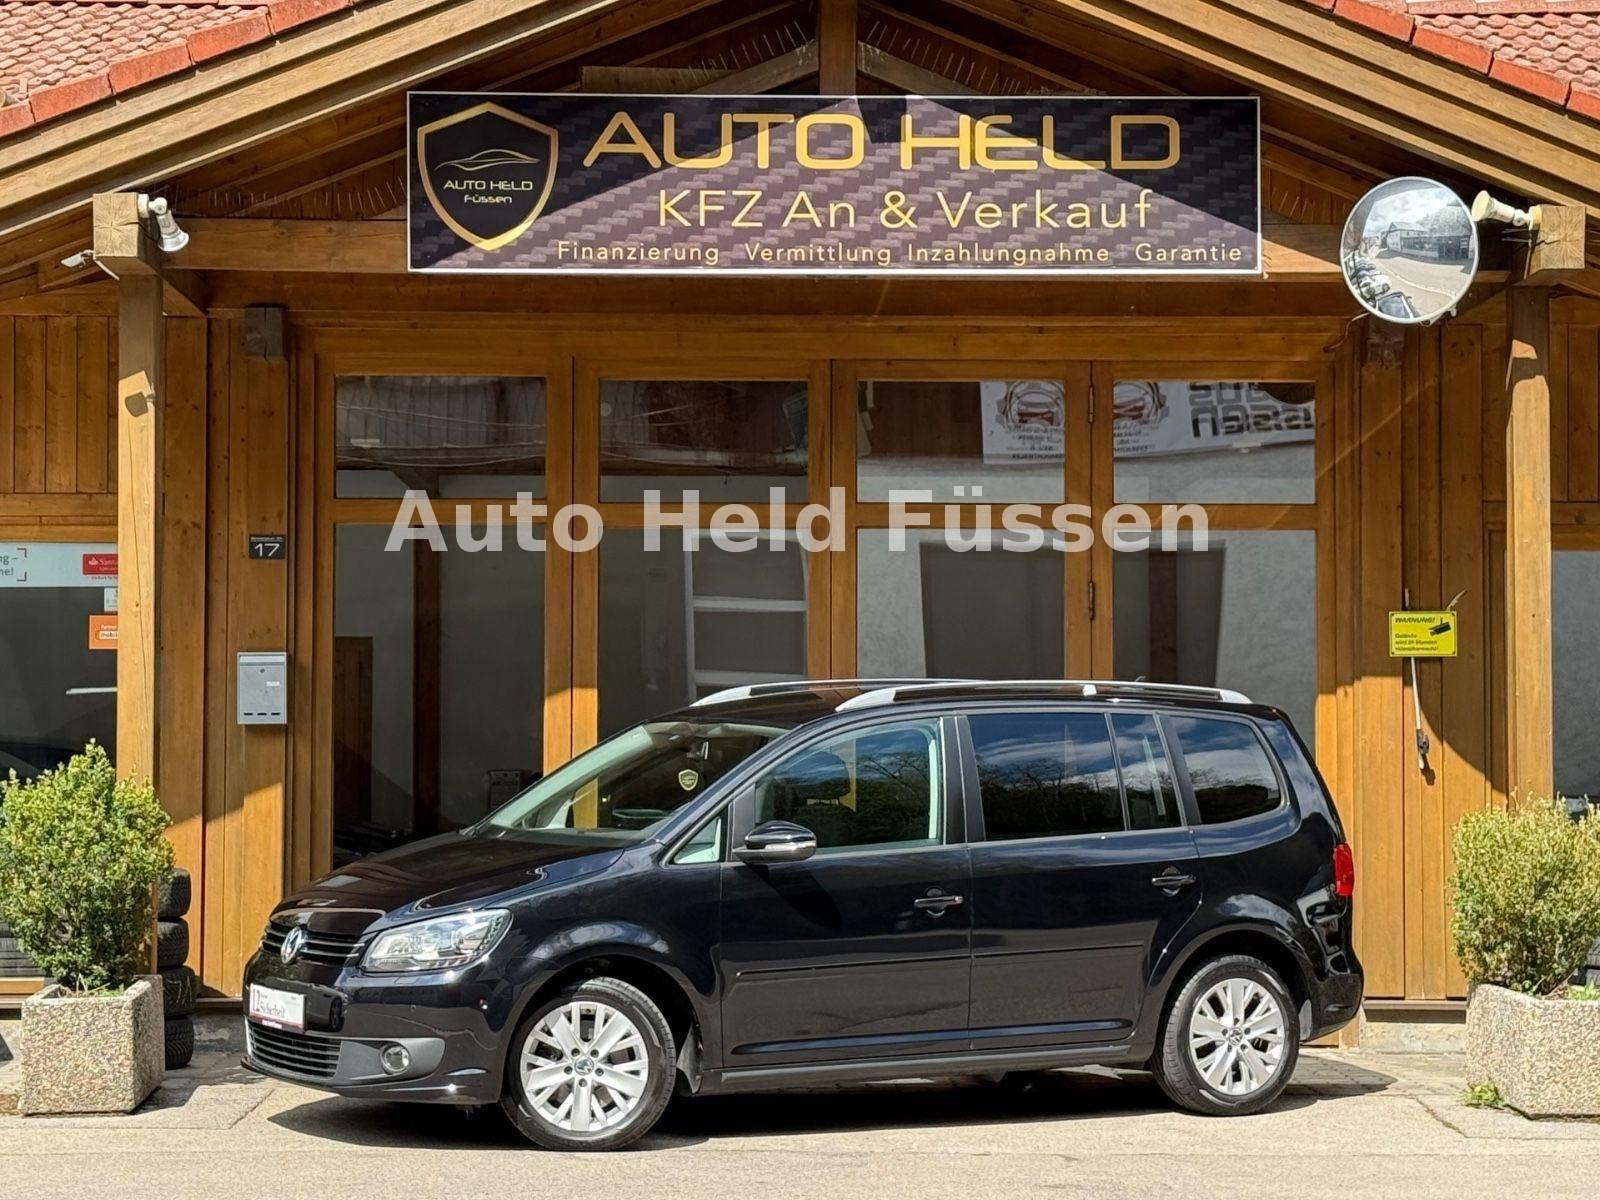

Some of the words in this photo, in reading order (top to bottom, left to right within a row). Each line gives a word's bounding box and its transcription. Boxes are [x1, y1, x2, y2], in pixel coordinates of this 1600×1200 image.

[582, 111, 866, 170] AUTO
[900, 113, 1181, 170] HELD
[443, 179, 486, 190] AUTO
[490, 180, 533, 191] HELD
[463, 193, 512, 204] Füssen
[658, 189, 763, 228] KFZ
[782, 190, 856, 228] An
[879, 189, 918, 229] &
[936, 189, 1153, 229] Verkauf
[557, 241, 720, 264] Finanzierung
[744, 241, 891, 265] Vermittlung
[907, 243, 1110, 266] Inzahlungnahme
[1135, 243, 1242, 262] Garantie
[254, 543, 280, 557] 17
